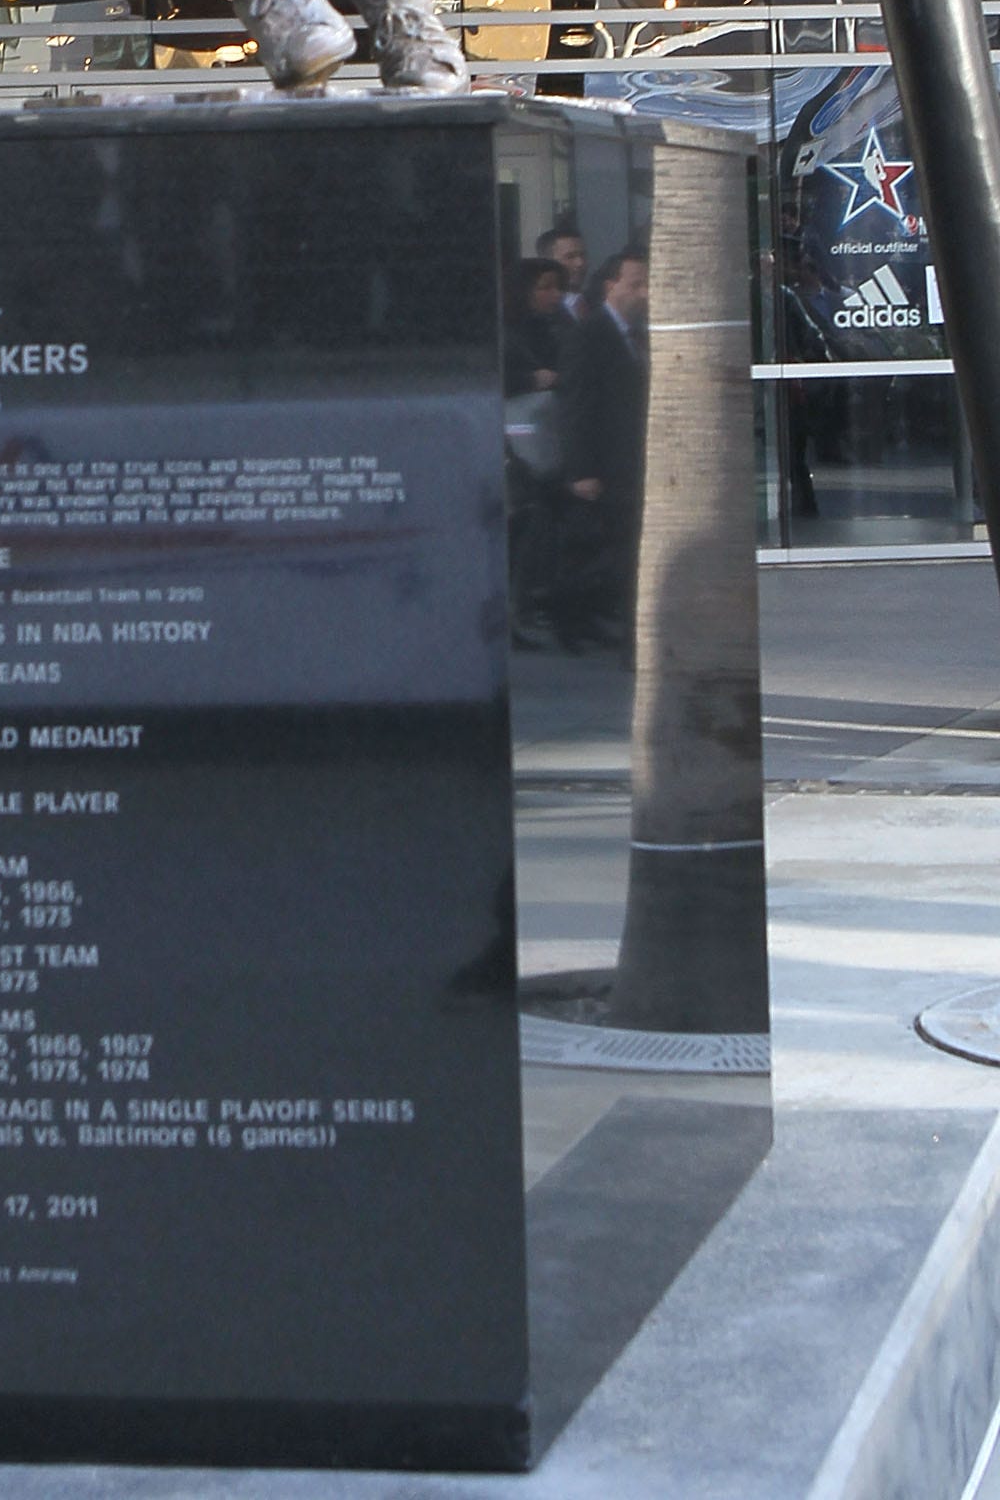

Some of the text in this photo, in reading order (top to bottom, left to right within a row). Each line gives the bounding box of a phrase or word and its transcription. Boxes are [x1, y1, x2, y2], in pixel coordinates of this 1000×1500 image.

[830, 242, 919, 255] official outfitter
[833, 304, 921, 328] adidas
[17, 622, 41, 645] IN
[53, 622, 102, 645] NBA
[112, 621, 211, 644] HISTORY
[30, 725, 142, 749] MEDALIST
[34, 791, 119, 814] PLAYER
[35, 944, 98, 967] TEAM
[65, 1098, 89, 1121] IN
[100, 1098, 118, 1121] A
[127, 1098, 207, 1121] SINGLE
[220, 1098, 318, 1121] PLAYOFF
[333, 1099, 414, 1122] SERIES
[33, 1123, 65, 1148] vs.
[78, 1123, 197, 1149] Baltimore
[207, 1123, 232, 1149] (6
[241, 1124, 337, 1150] games))
[4, 1195, 36, 1218] 17,
[47, 1195, 98, 1218] 2011
